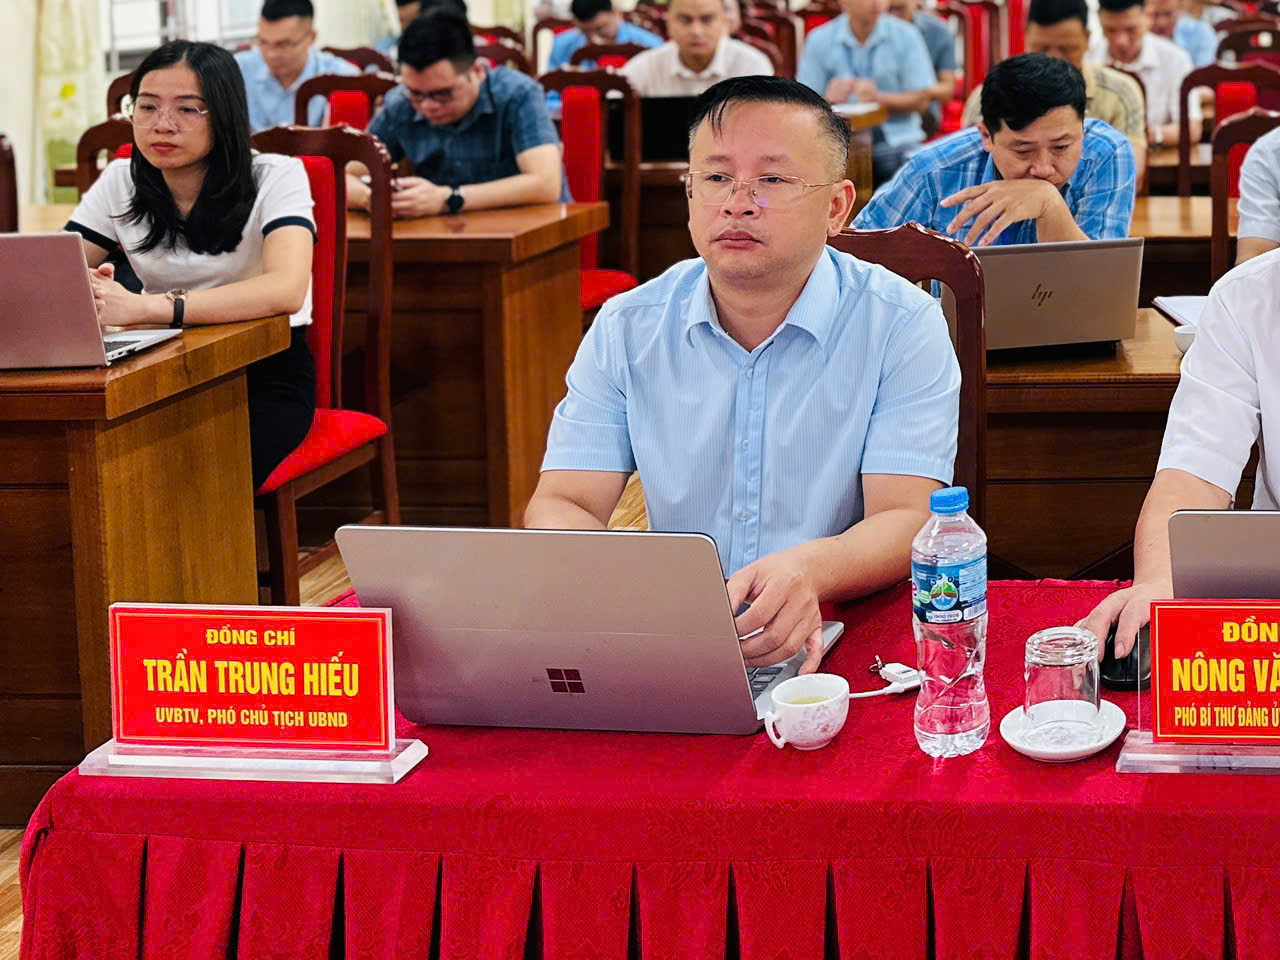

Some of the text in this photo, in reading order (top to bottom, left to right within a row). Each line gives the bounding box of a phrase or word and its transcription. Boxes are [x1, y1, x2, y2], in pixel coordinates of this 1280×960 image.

[206, 624, 296, 646] ĐỒNG CHÍ
[143, 648, 359, 697] TRẦN TRUNG HIẾU
[1172, 651, 1245, 692] NÔNG
[155, 704, 349, 730] UVBTV, PHÓ CHỦ TỊCH UBND
[1174, 702, 1197, 727] PHÓ
[1199, 702, 1212, 727] BÍ
[1213, 705, 1237, 727] THƯ
[1237, 701, 1269, 727] ĐẢNG
